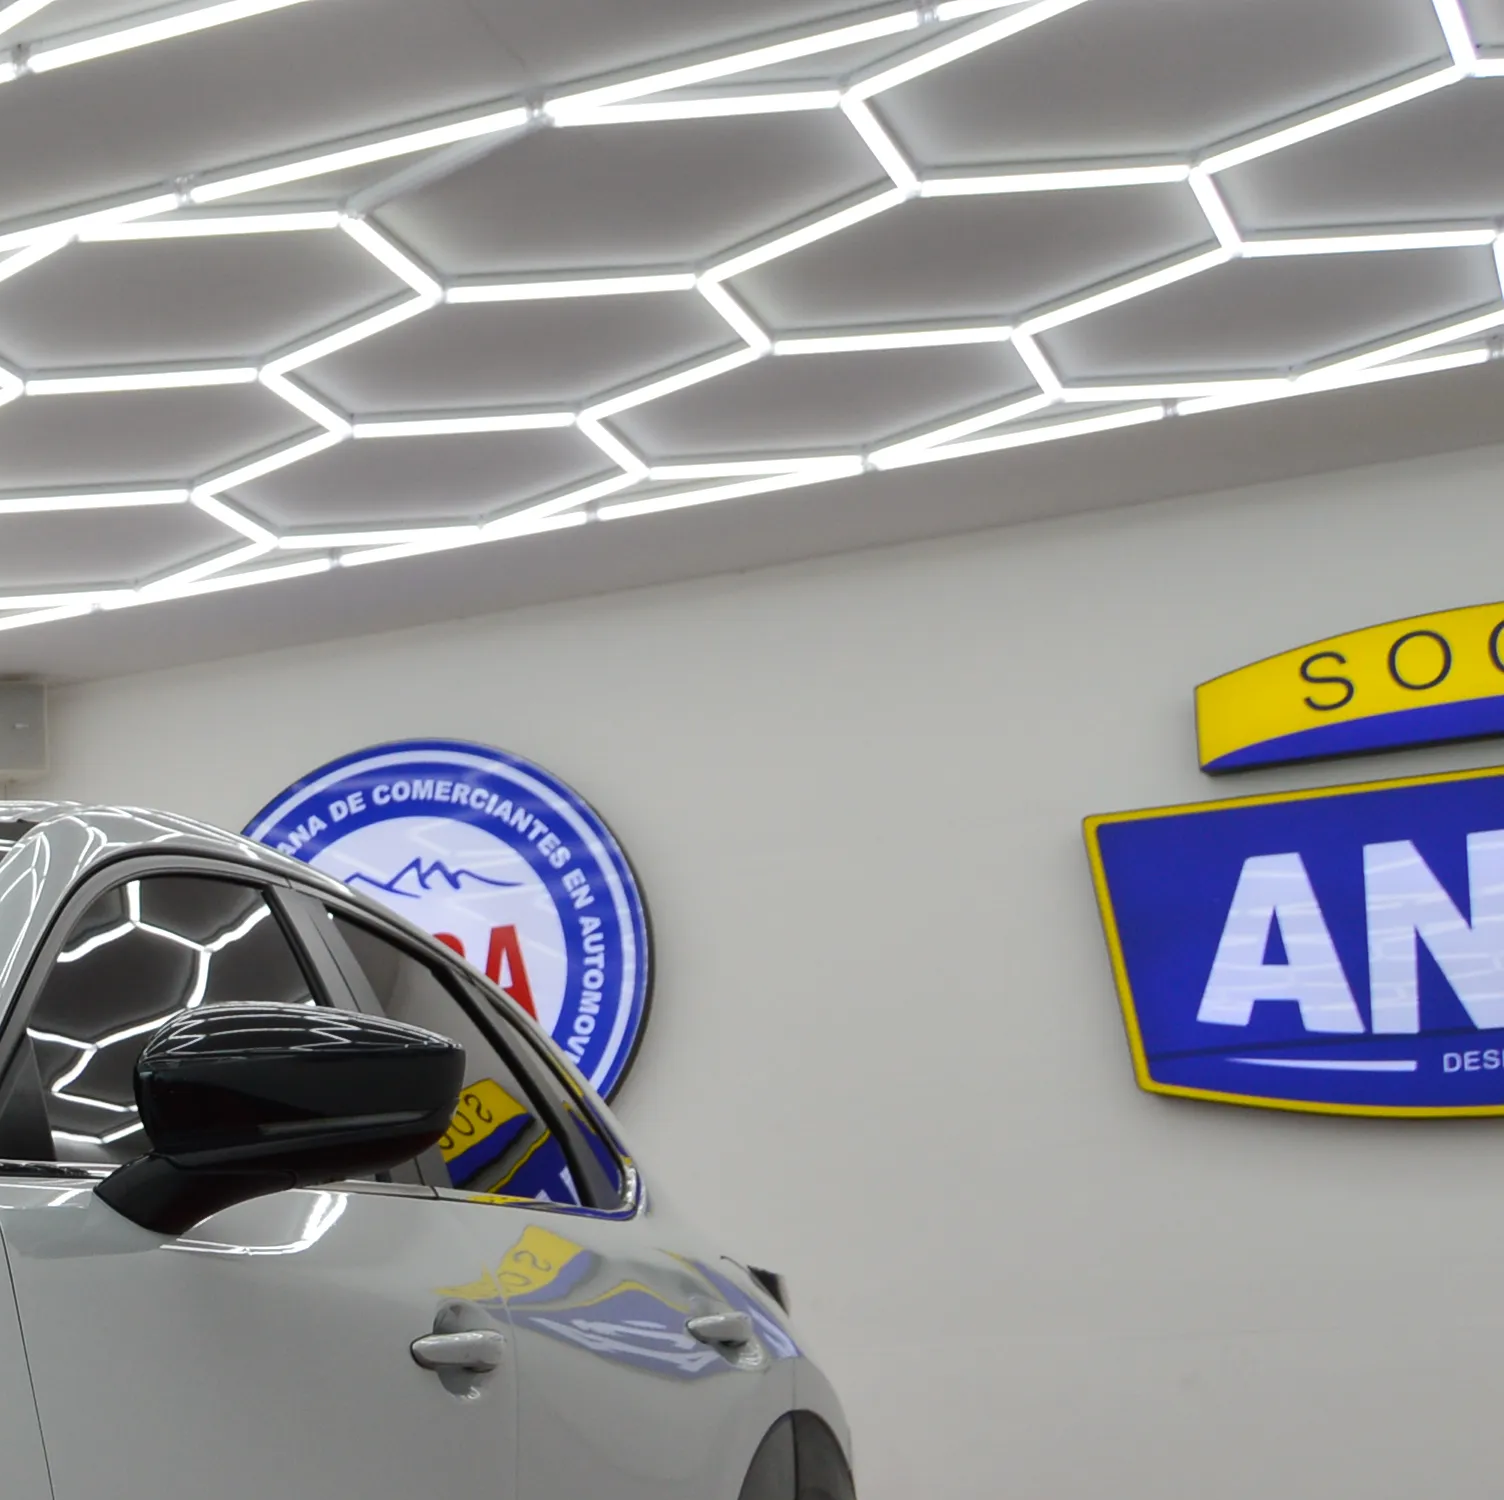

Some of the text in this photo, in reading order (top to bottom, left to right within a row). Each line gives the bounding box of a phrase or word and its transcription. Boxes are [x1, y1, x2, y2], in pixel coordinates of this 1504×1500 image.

[1299, 619, 1504, 711] SO
[329, 791, 367, 823] DE
[372, 779, 572, 869] COMERCIANTES
[561, 868, 596, 910] EN
